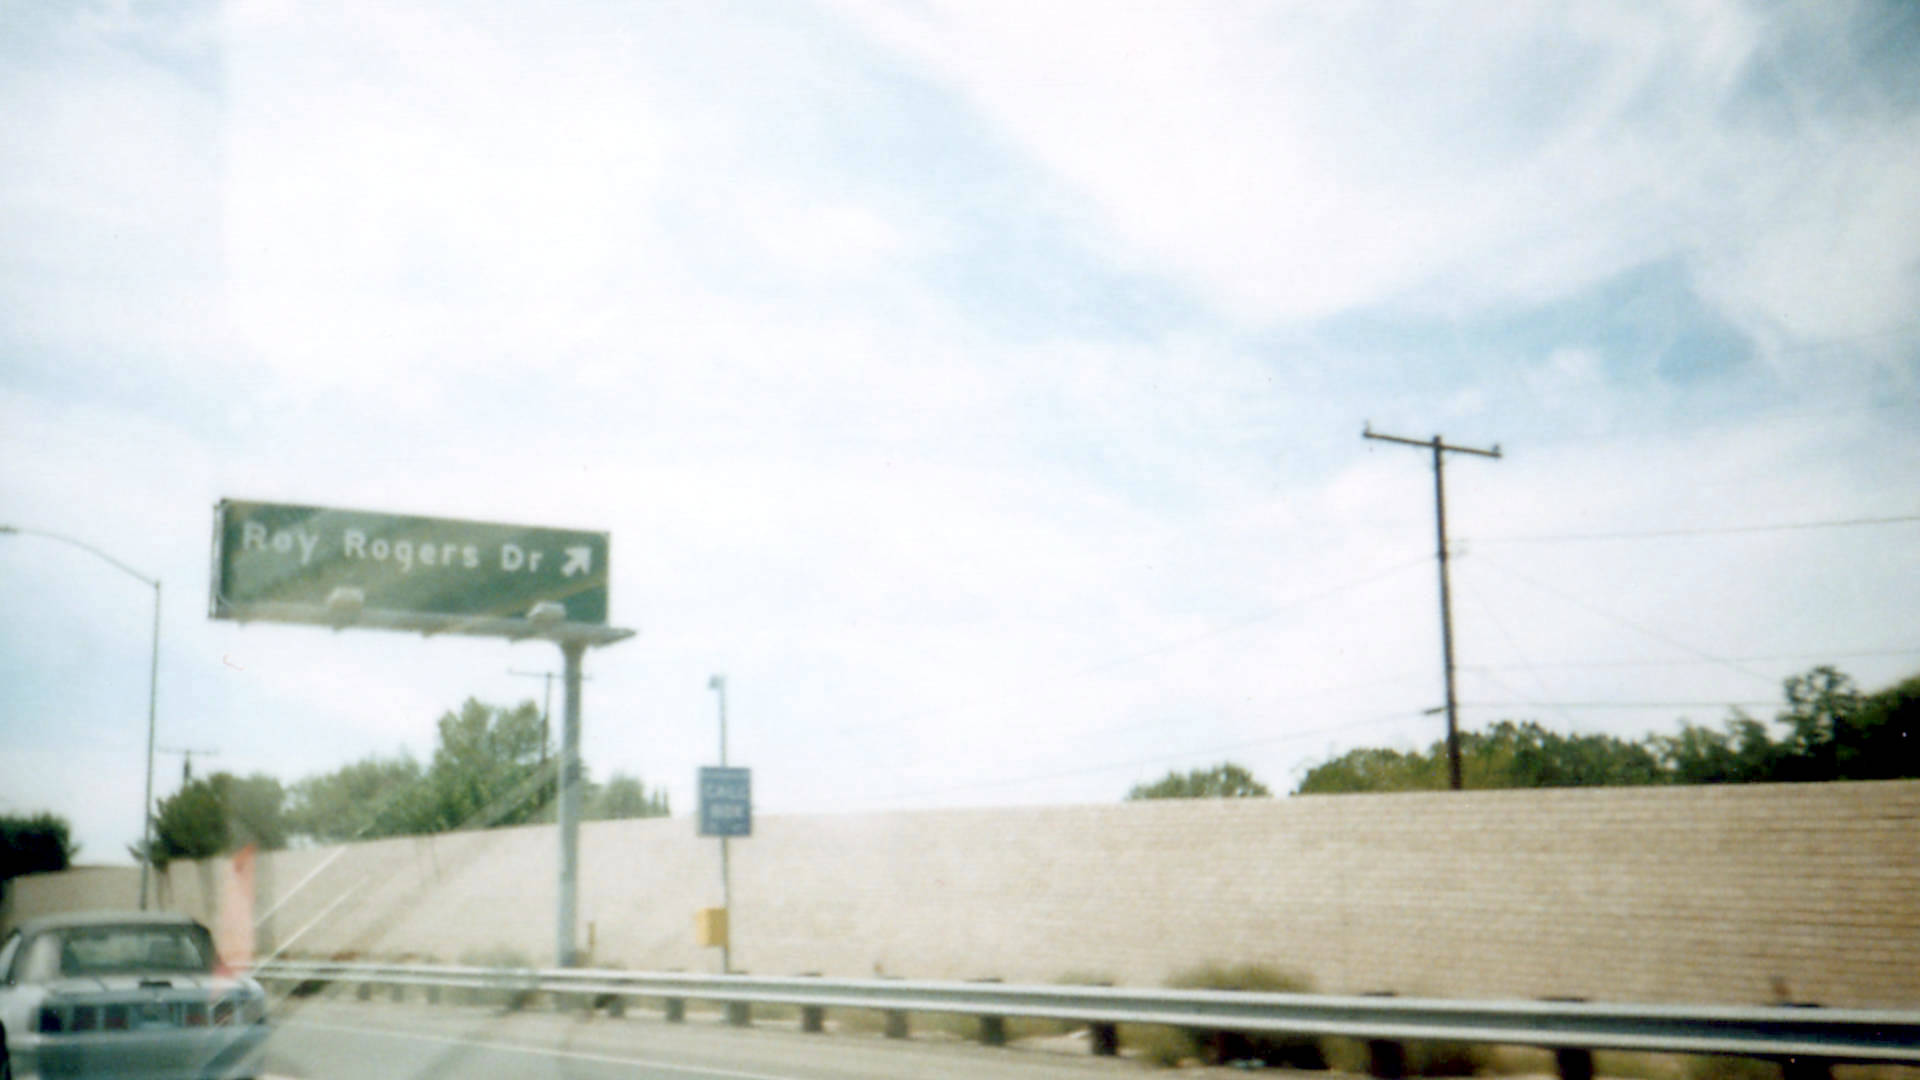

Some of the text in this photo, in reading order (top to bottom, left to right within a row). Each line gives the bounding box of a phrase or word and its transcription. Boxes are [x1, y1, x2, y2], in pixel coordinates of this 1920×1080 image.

[242, 522, 544, 573] Roy Rogers Dr
